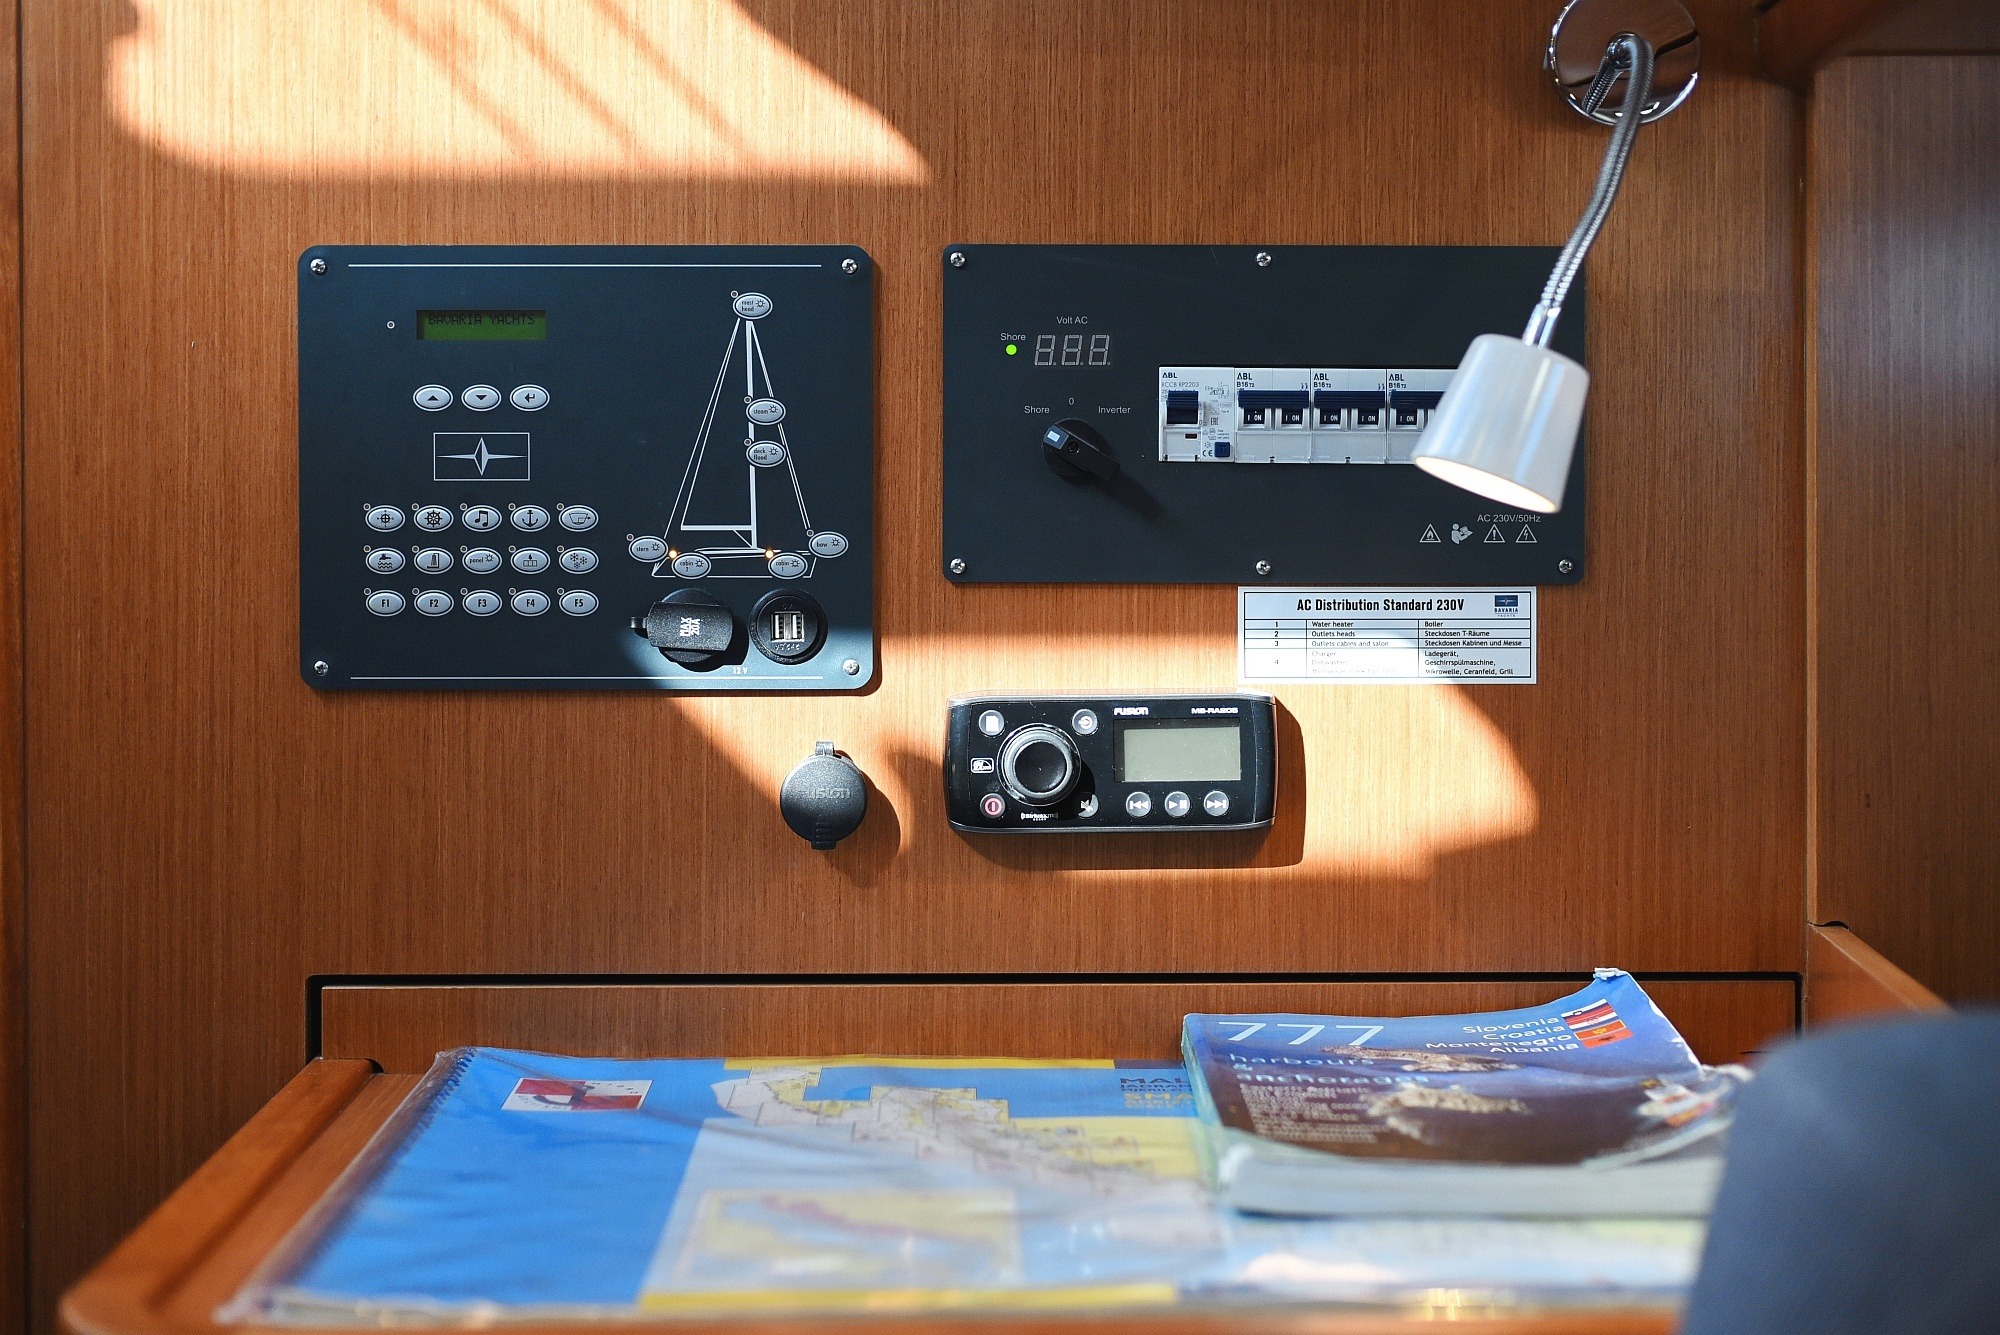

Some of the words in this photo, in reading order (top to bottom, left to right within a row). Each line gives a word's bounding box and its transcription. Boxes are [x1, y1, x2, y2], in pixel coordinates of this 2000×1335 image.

[428, 314, 482, 325] BAVARIA
[490, 314, 535, 325] YACHTS
[1056, 316, 1072, 324] Volt
[1074, 316, 1088, 324] AC
[1000, 333, 1026, 341] Shore
[1388, 373, 1404, 381] ABL
[1024, 405, 1050, 414] Shore
[1098, 406, 1131, 414] Inverter
[1477, 514, 1491, 522] AC
[1493, 514, 1541, 523] 230V/50Hz
[469, 557, 484, 565] panel
[381, 599, 390, 608] F1
[429, 599, 439, 608] F2
[478, 599, 487, 608] F3
[526, 599, 535, 608] F4
[574, 599, 584, 608] F5
[1297, 599, 1312, 611] AC
[1316, 599, 1380, 611] Distribution
[1383, 599, 1433, 611] Standard
[1436, 599, 1464, 611] 230V
[680, 617, 690, 636] MAX
[691, 618, 701, 635] 20A
[1113, 707, 1149, 715] FUSION
[1462, 1016, 1559, 1034] Slovenia
[1218, 1021, 1384, 1046] 777
[1482, 1025, 1566, 1041] Croatia
[1425, 1033, 1572, 1049] Montenegro
[1490, 1042, 1579, 1053] Albania
[1230, 1053, 1374, 1066] harbours
[1236, 1073, 1429, 1084] anchorages
